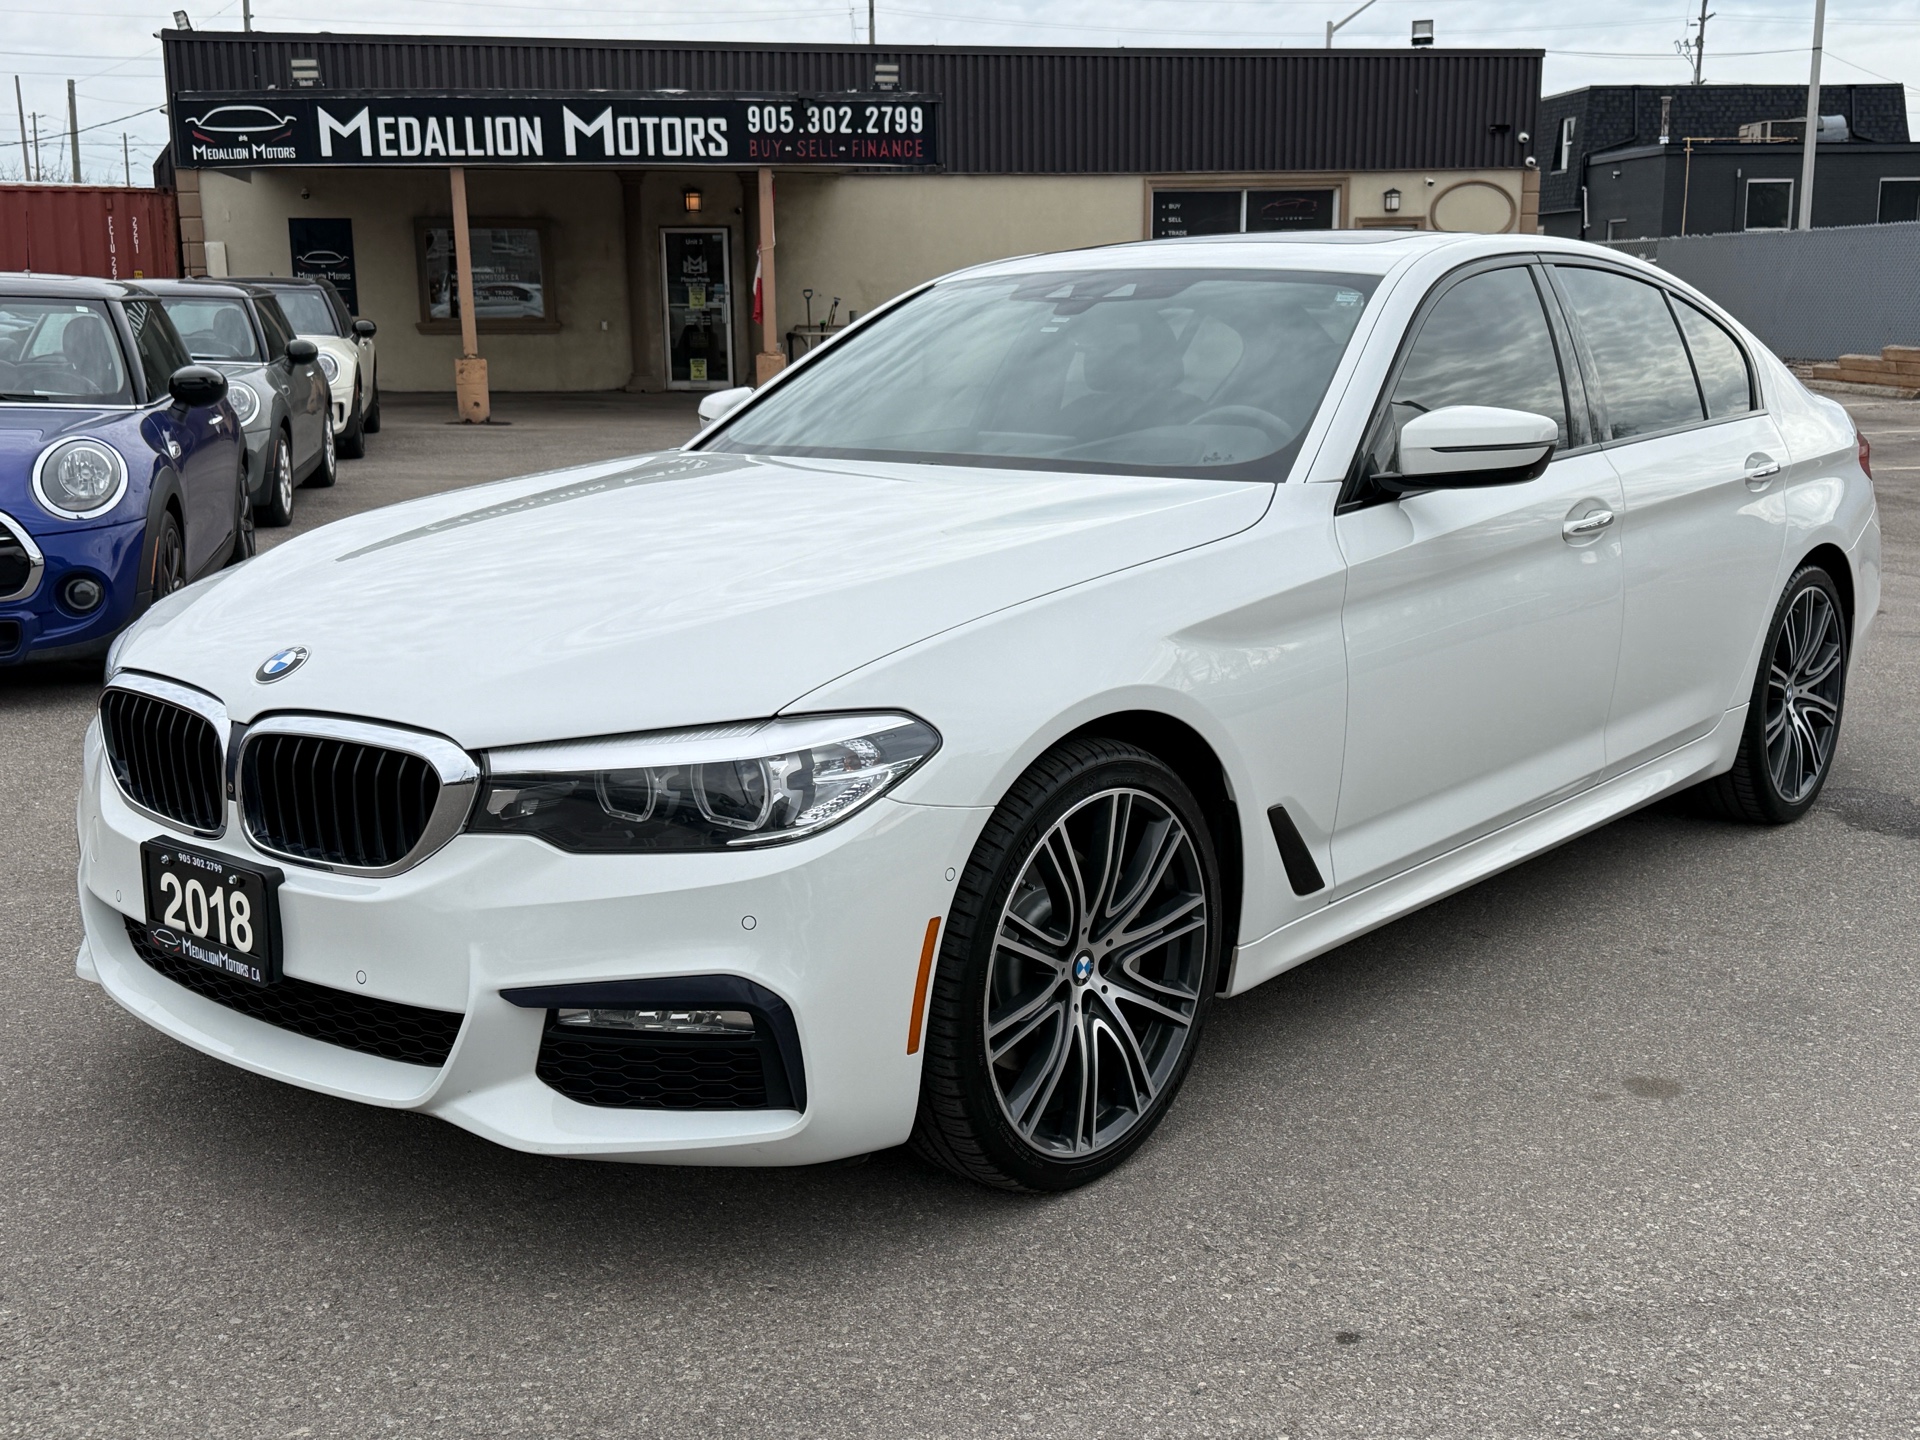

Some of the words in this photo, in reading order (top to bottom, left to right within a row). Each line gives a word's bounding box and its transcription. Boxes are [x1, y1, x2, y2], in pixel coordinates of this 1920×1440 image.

[317, 106, 543, 157] MEDALLION
[562, 105, 728, 157] MOTORS
[747, 106, 923, 134] 905.302.2799
[191, 144, 249, 160] MEDALLION
[252, 143, 296, 159] MOTORS
[749, 140, 783, 157] BUY
[797, 140, 838, 157] SELL
[852, 140, 923, 157] FINANCE
[178, 852, 191, 864] 905
[192, 856, 205, 869] 302
[206, 860, 223, 874] 2799
[160, 872, 253, 953] 2018
